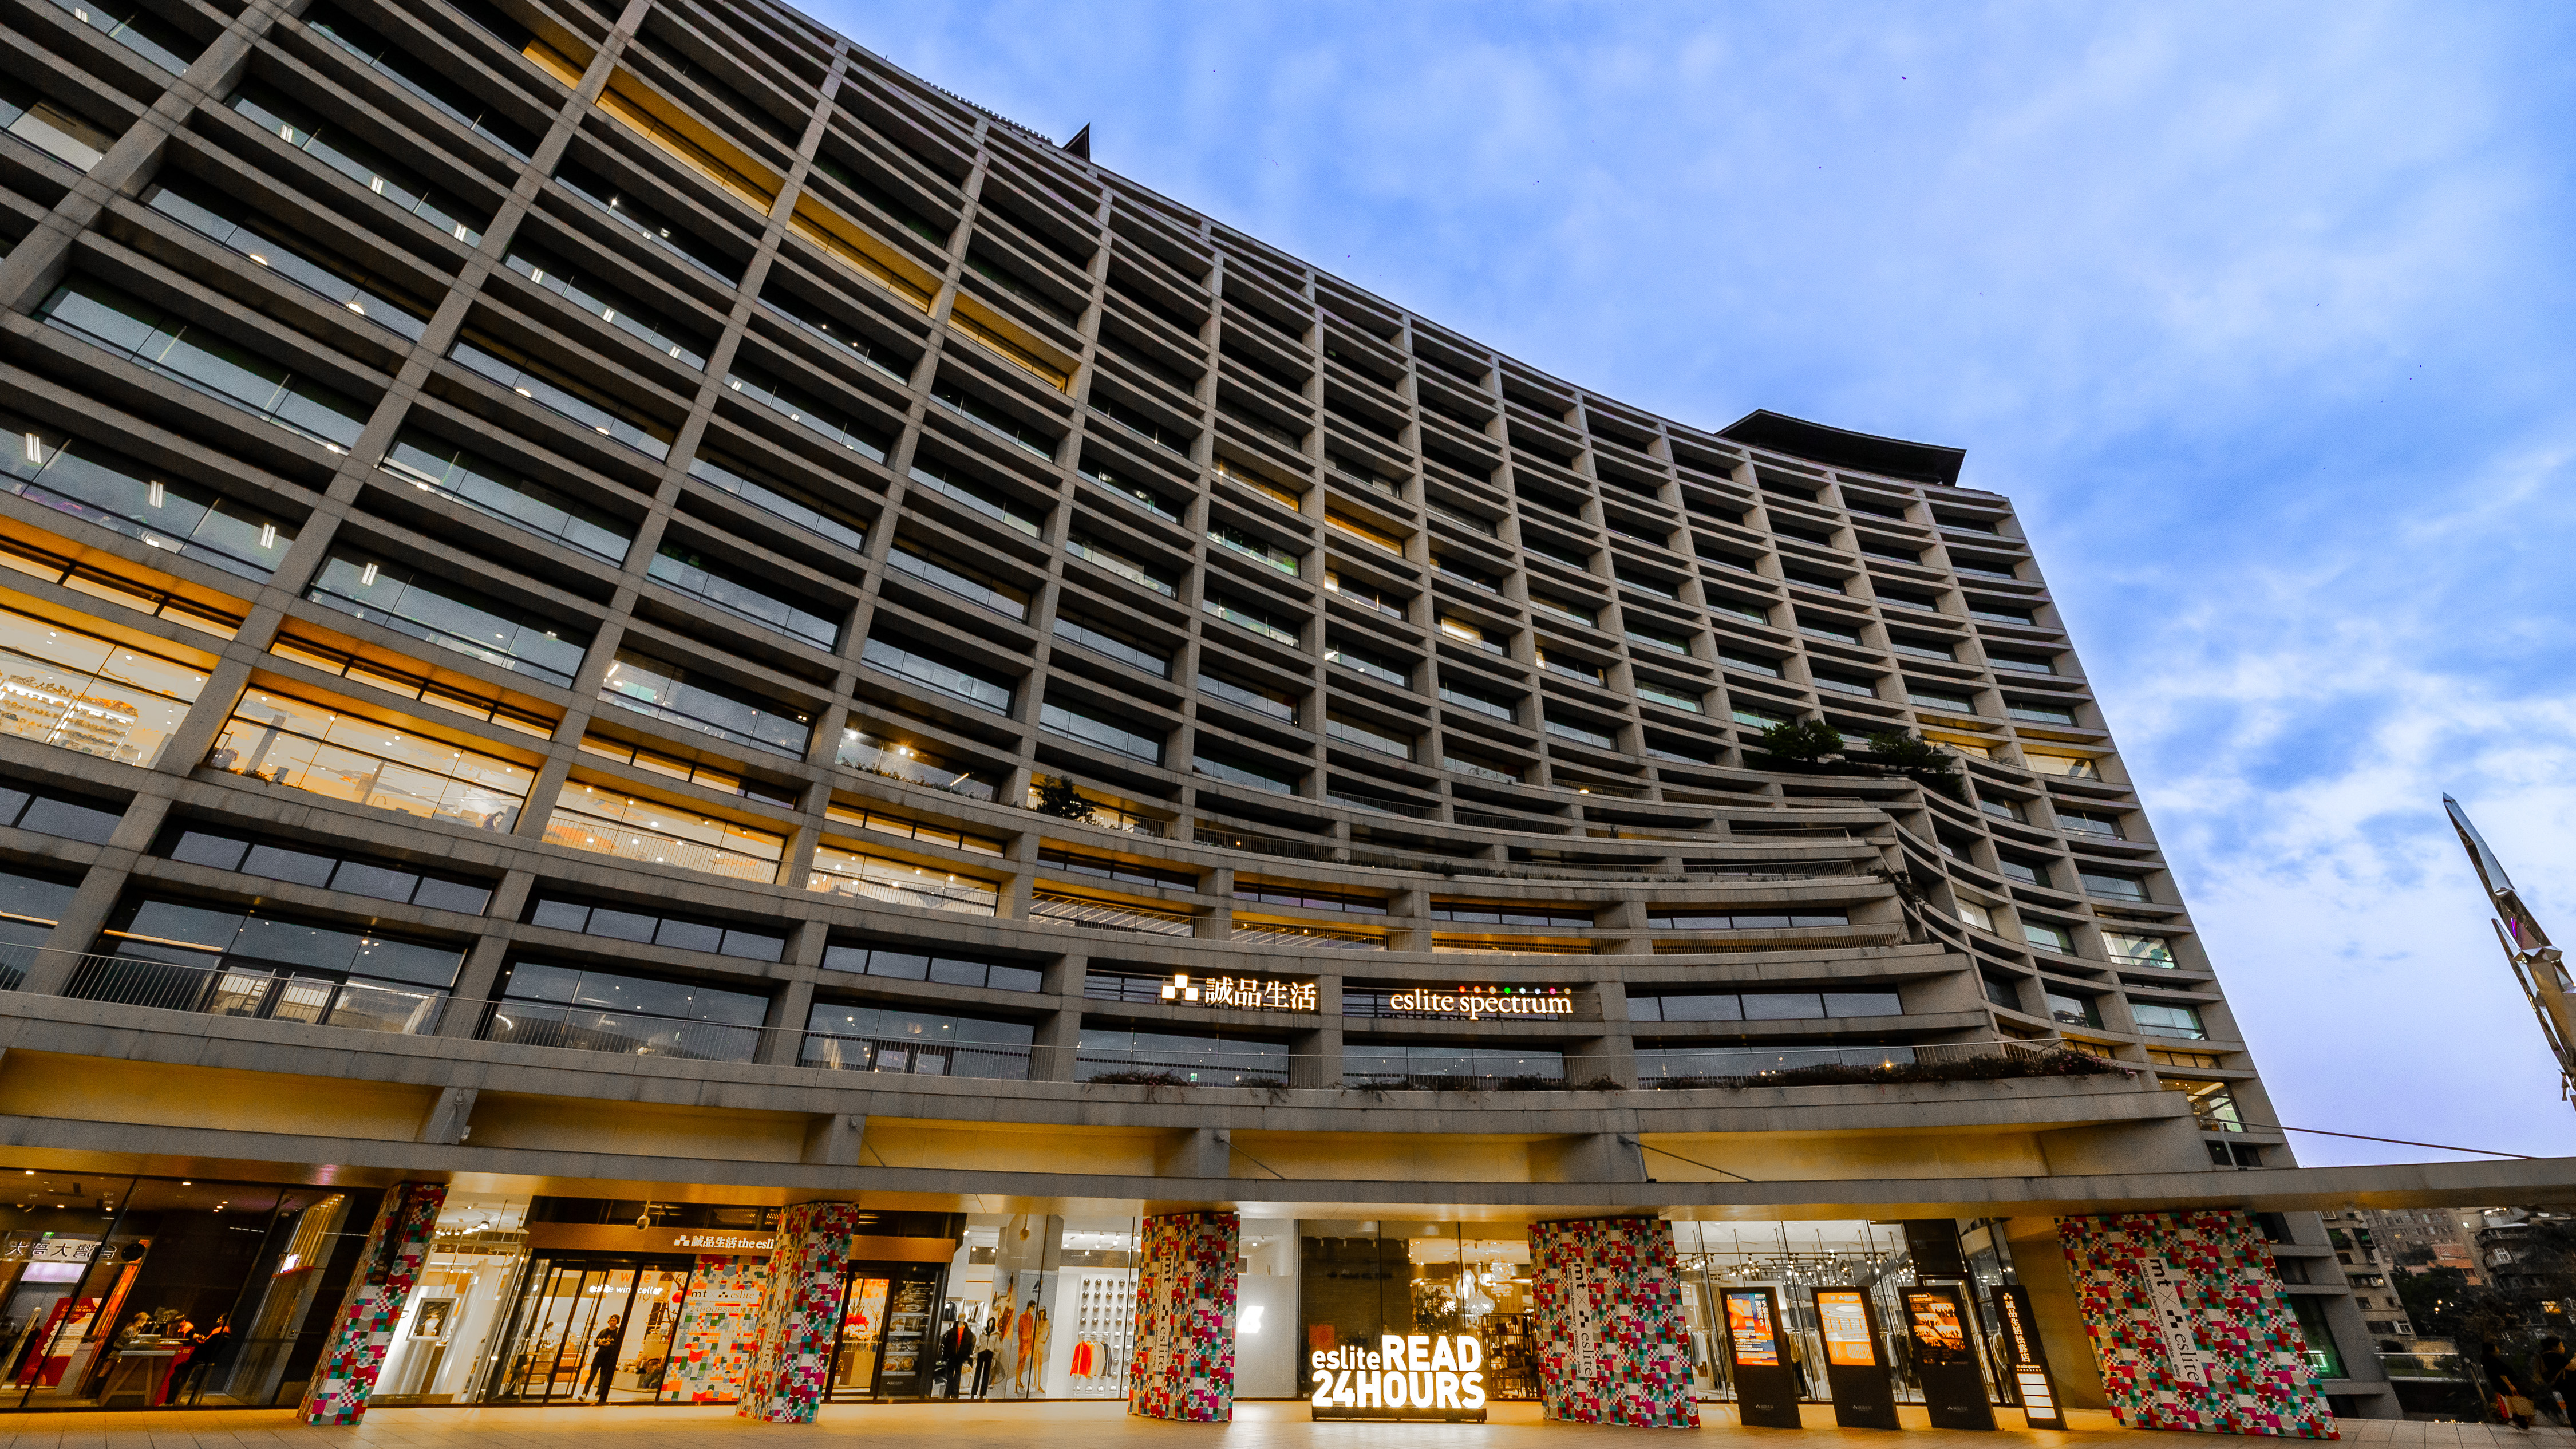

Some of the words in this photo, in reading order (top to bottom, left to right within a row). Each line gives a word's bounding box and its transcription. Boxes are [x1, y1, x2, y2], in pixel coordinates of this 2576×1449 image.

[1205, 976, 1316, 1010] 誠品生活
[1390, 988, 1454, 1011] eslite
[1460, 995, 1573, 1020] spectrum
[691, 1235, 737, 1249] 誠品生活
[738, 1238, 754, 1248] the
[756, 1238, 774, 1250] esli
[1164, 1257, 1171, 1283] mt
[616, 1285, 630, 1293] win
[730, 1291, 754, 1299] eslite
[1574, 1264, 1586, 1289] mt
[1581, 1332, 1594, 1376] eslite
[2139, 1259, 2149, 1278] KAMOI
[2151, 1294, 2165, 1328] Anniversary
[2163, 1330, 2175, 1359] exhibition
[2174, 1364, 2182, 1379] shop
[2148, 1259, 2172, 1287] mt
[2175, 1333, 2199, 1381] eslite
[1158, 1326, 1168, 1370] eslite
[1312, 1345, 1381, 1370] eslite
[1382, 1334, 1481, 1371] READ
[1312, 1369, 1485, 1409] 24HOURS
